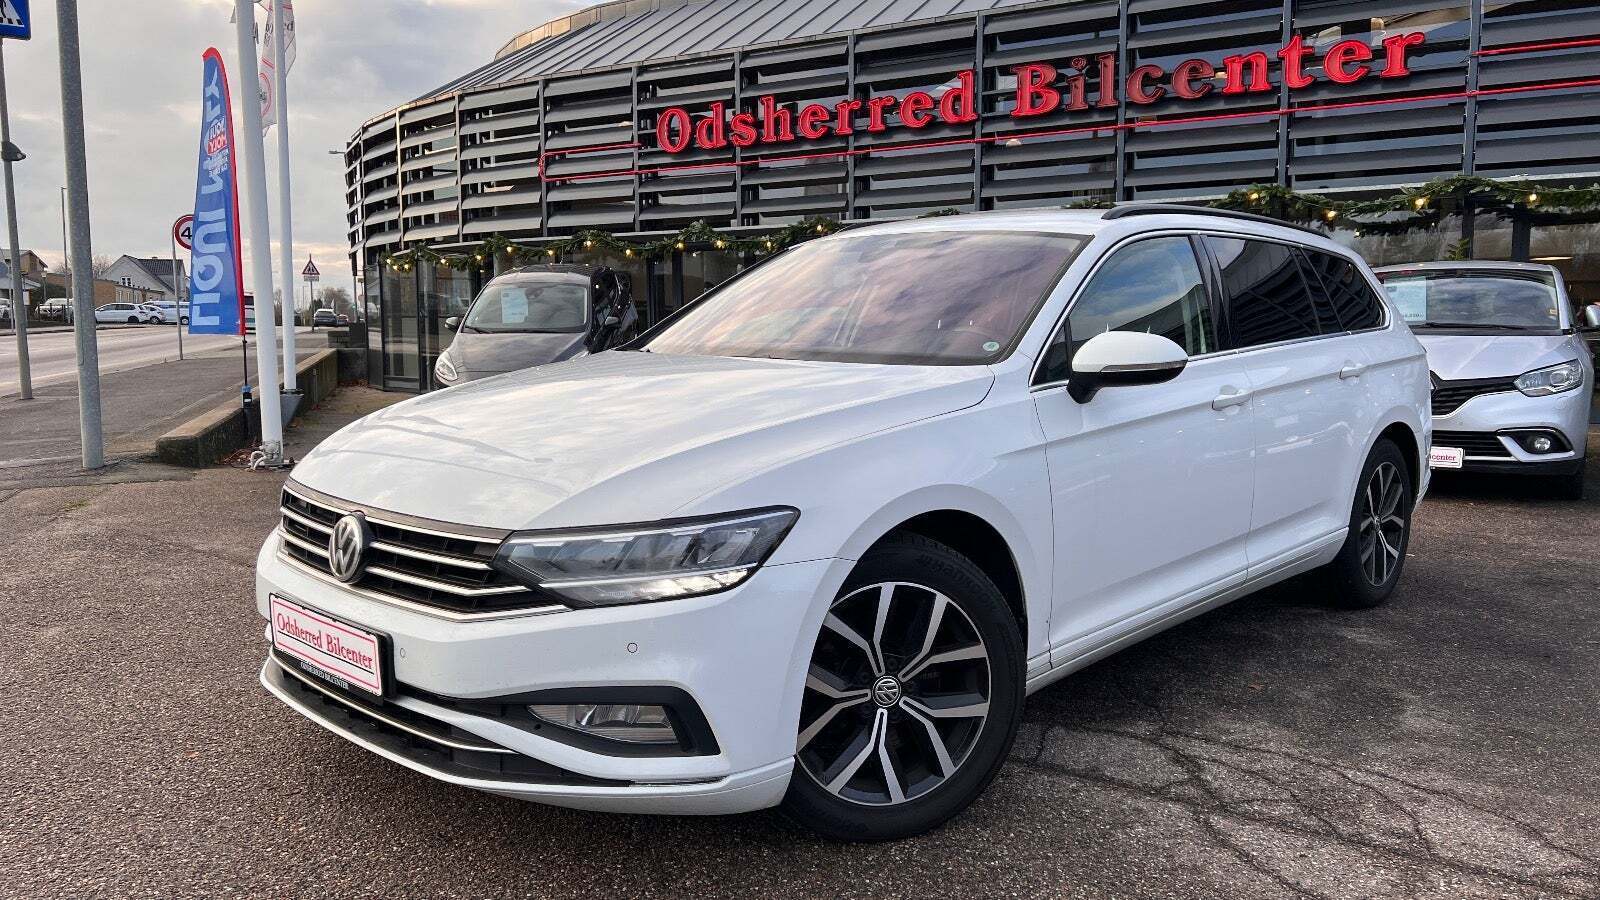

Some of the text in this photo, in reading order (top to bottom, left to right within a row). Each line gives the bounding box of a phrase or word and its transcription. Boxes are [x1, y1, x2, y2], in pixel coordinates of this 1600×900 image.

[656, 31, 1426, 154] Odsherred Bilcenter
[181, 226, 193, 239] 4
[277, 612, 373, 670] Odsherred Bilcenter
